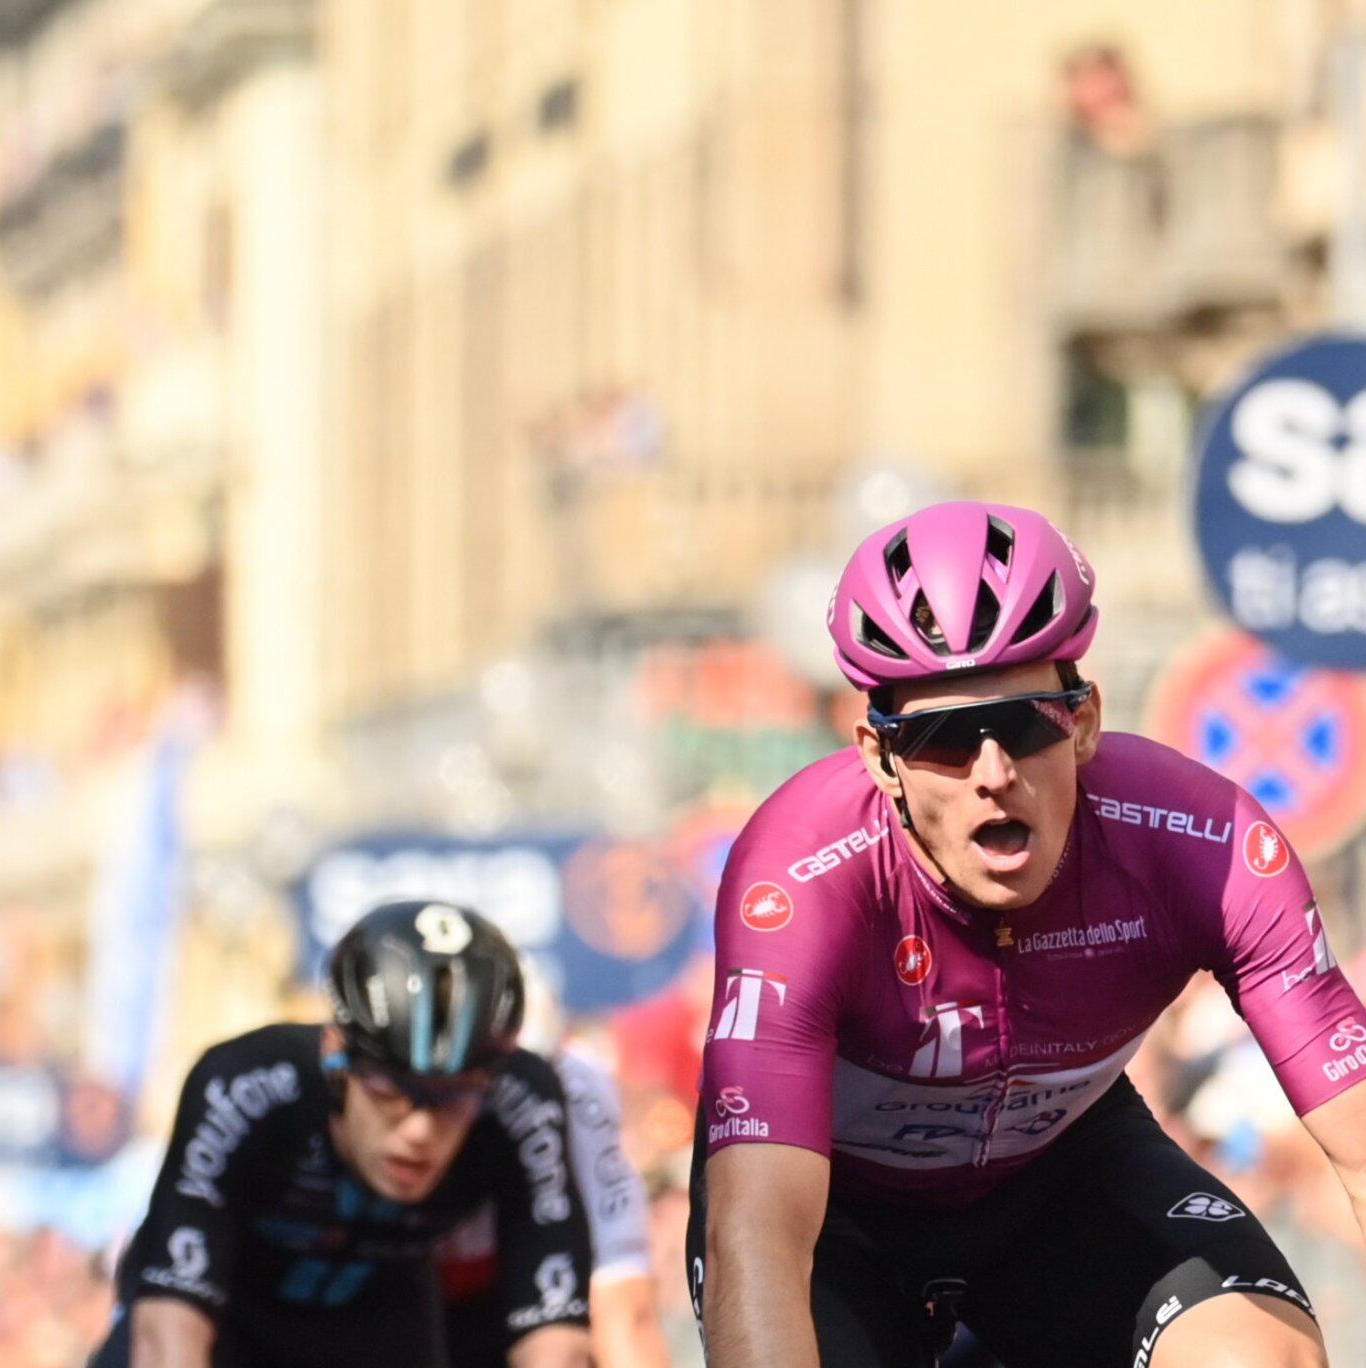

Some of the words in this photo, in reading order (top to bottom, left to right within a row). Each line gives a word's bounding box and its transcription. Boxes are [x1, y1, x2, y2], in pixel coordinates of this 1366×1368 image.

[1018, 938, 1033, 954] La
[1033, 924, 1086, 952] Gazzetta
[1086, 920, 1116, 947] dello
[1115, 915, 1148, 945] Sport
[1322, 1054, 1359, 1082] Giro
